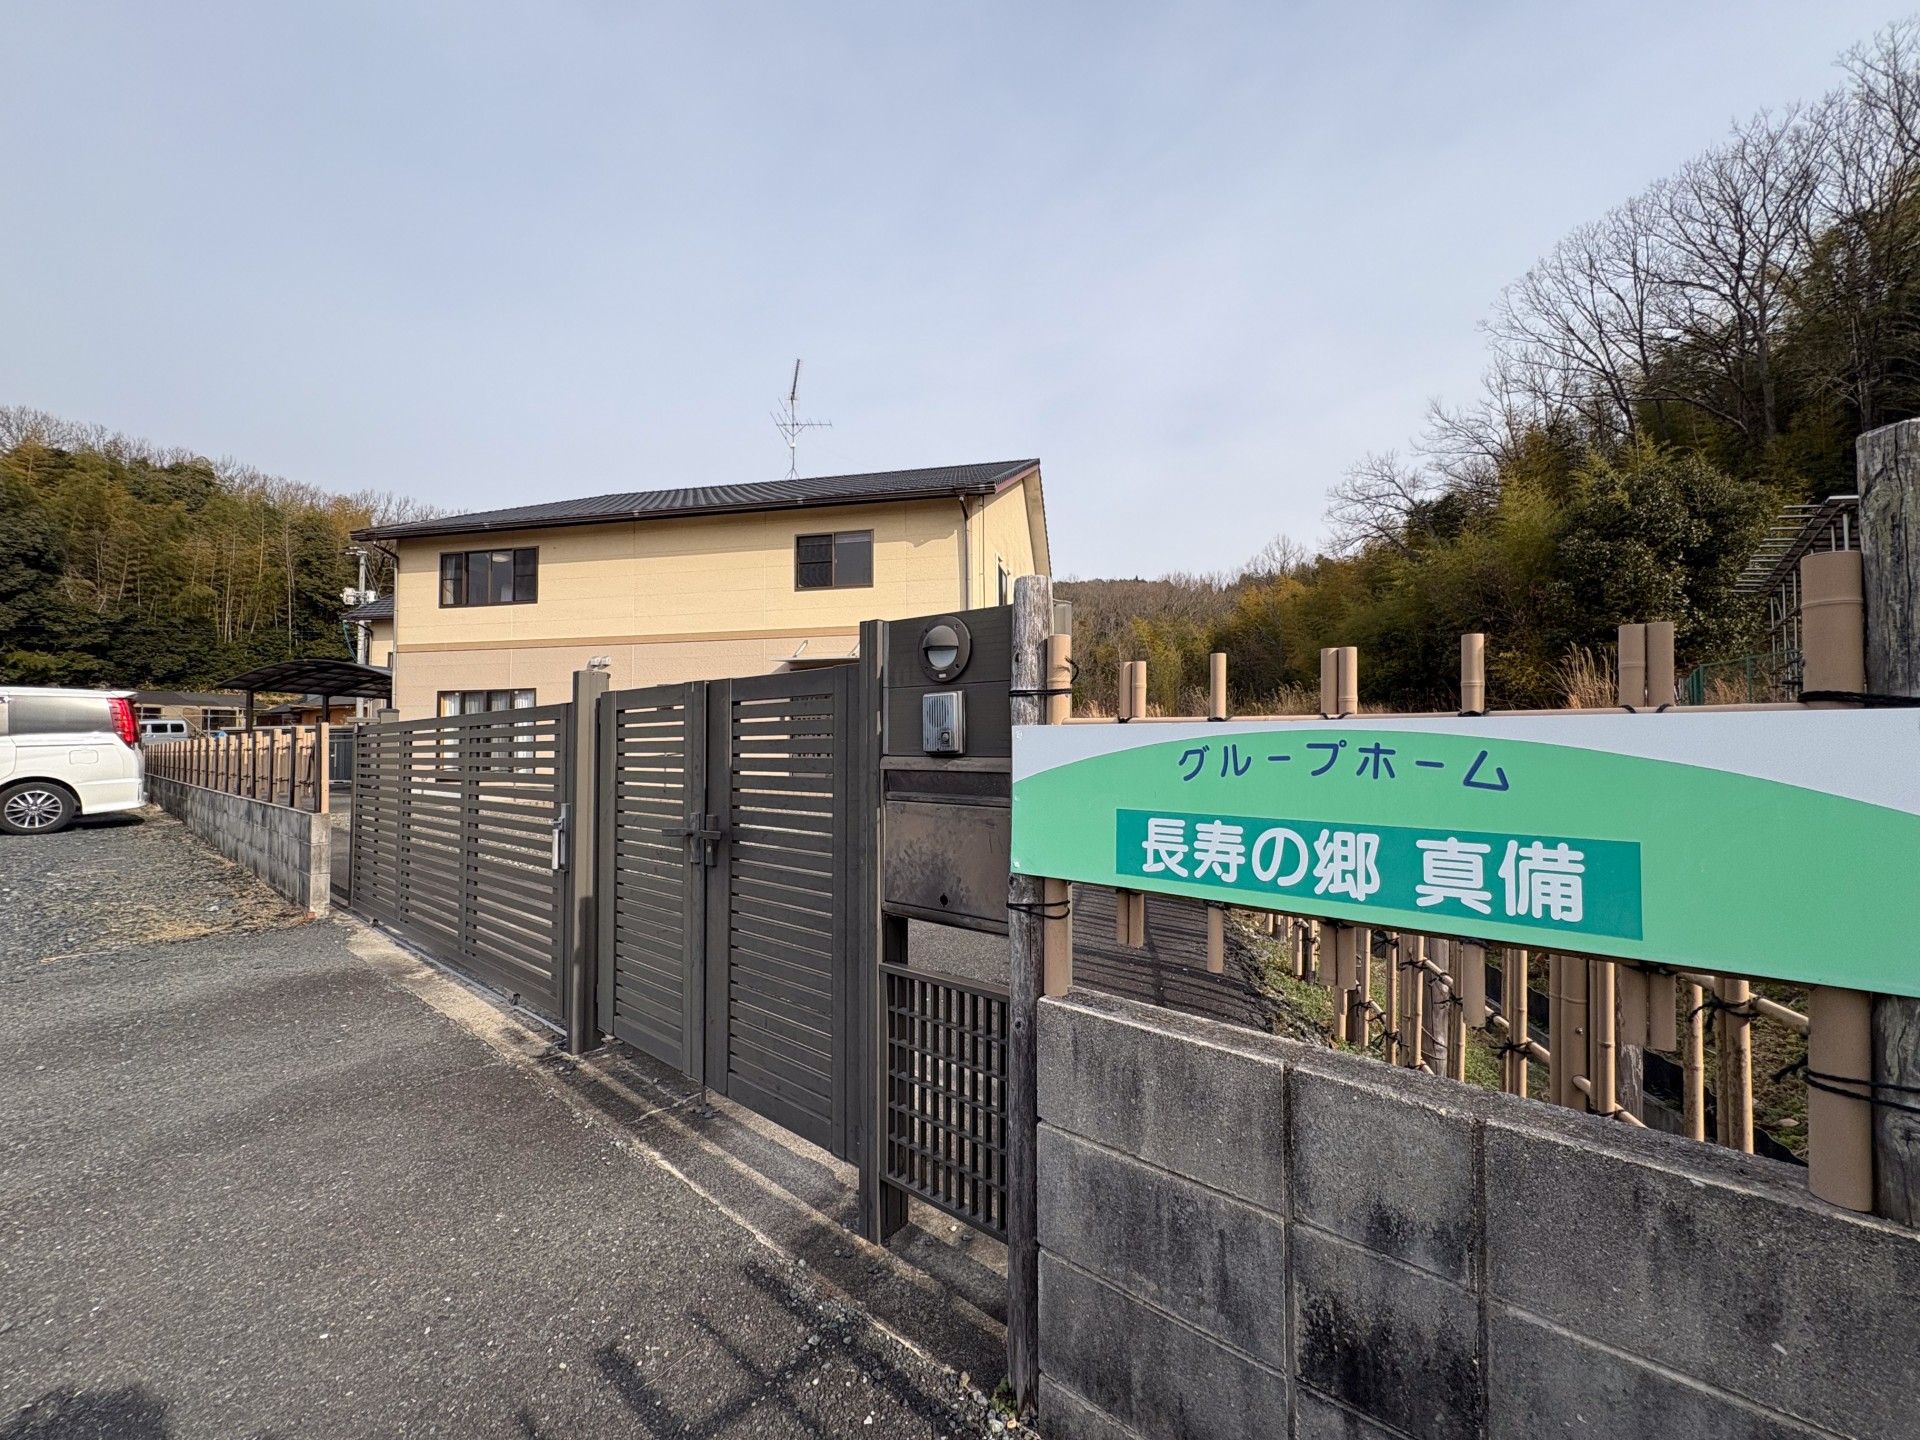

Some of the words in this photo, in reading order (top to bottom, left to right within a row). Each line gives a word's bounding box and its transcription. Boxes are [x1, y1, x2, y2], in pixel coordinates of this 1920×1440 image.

[1178, 738, 1510, 792] グループホーム
[1141, 817, 1381, 902] 長寿の郷
[1415, 837, 1586, 923] 真備
